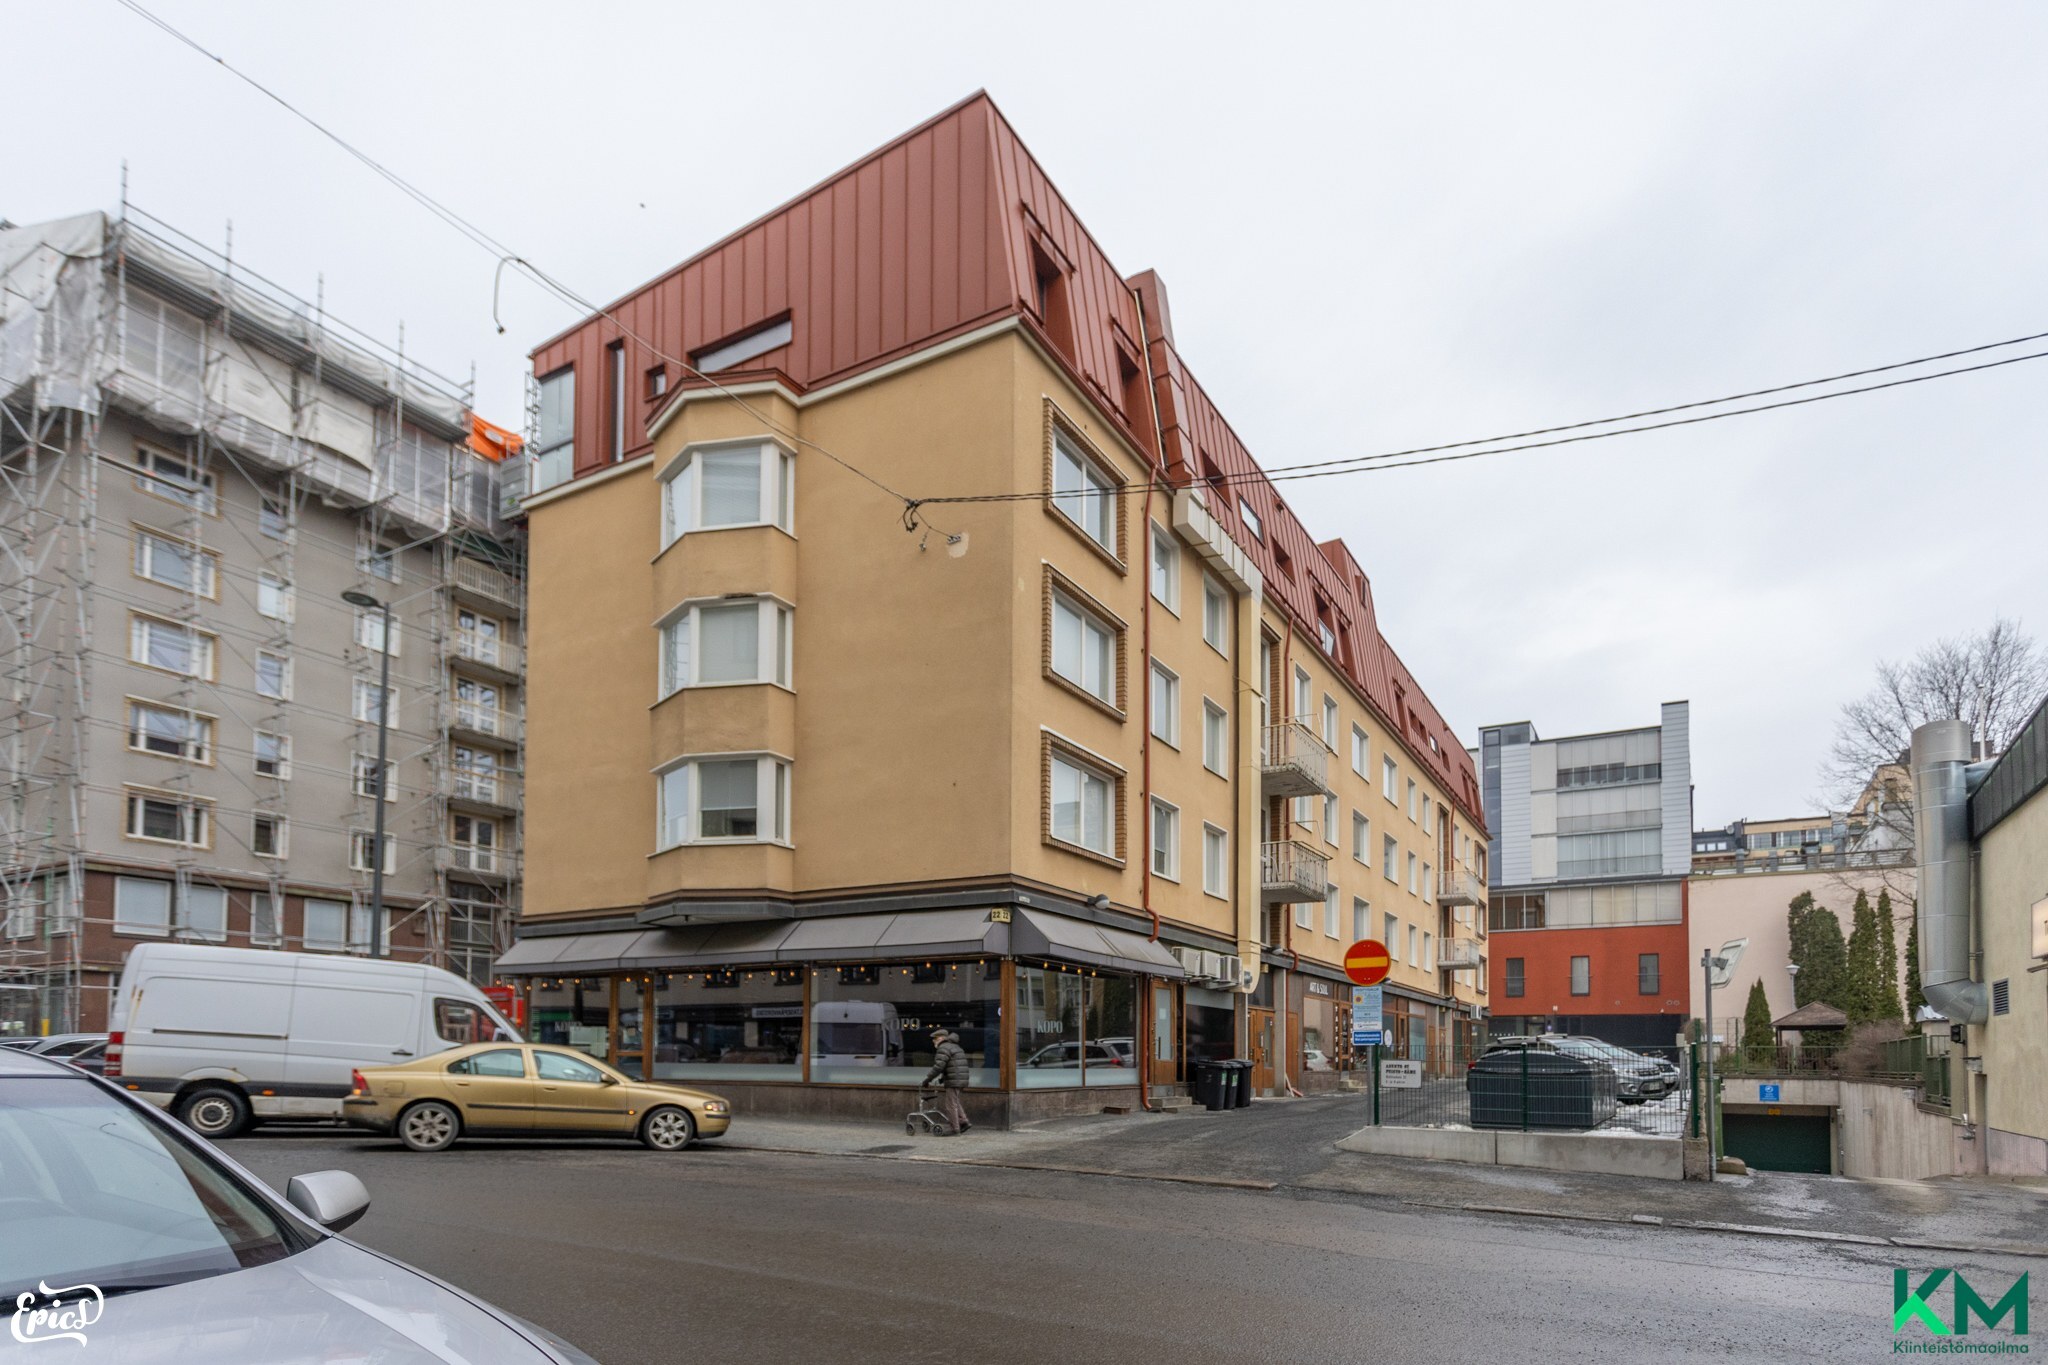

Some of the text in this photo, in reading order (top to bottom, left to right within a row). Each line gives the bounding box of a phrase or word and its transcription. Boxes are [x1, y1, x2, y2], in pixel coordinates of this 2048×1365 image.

[992, 911, 1001, 919] 22
[1320, 983, 1328, 995] SOUL
[881, 1017, 921, 1031] KOPO
[1037, 1020, 1063, 1033] KOPO
